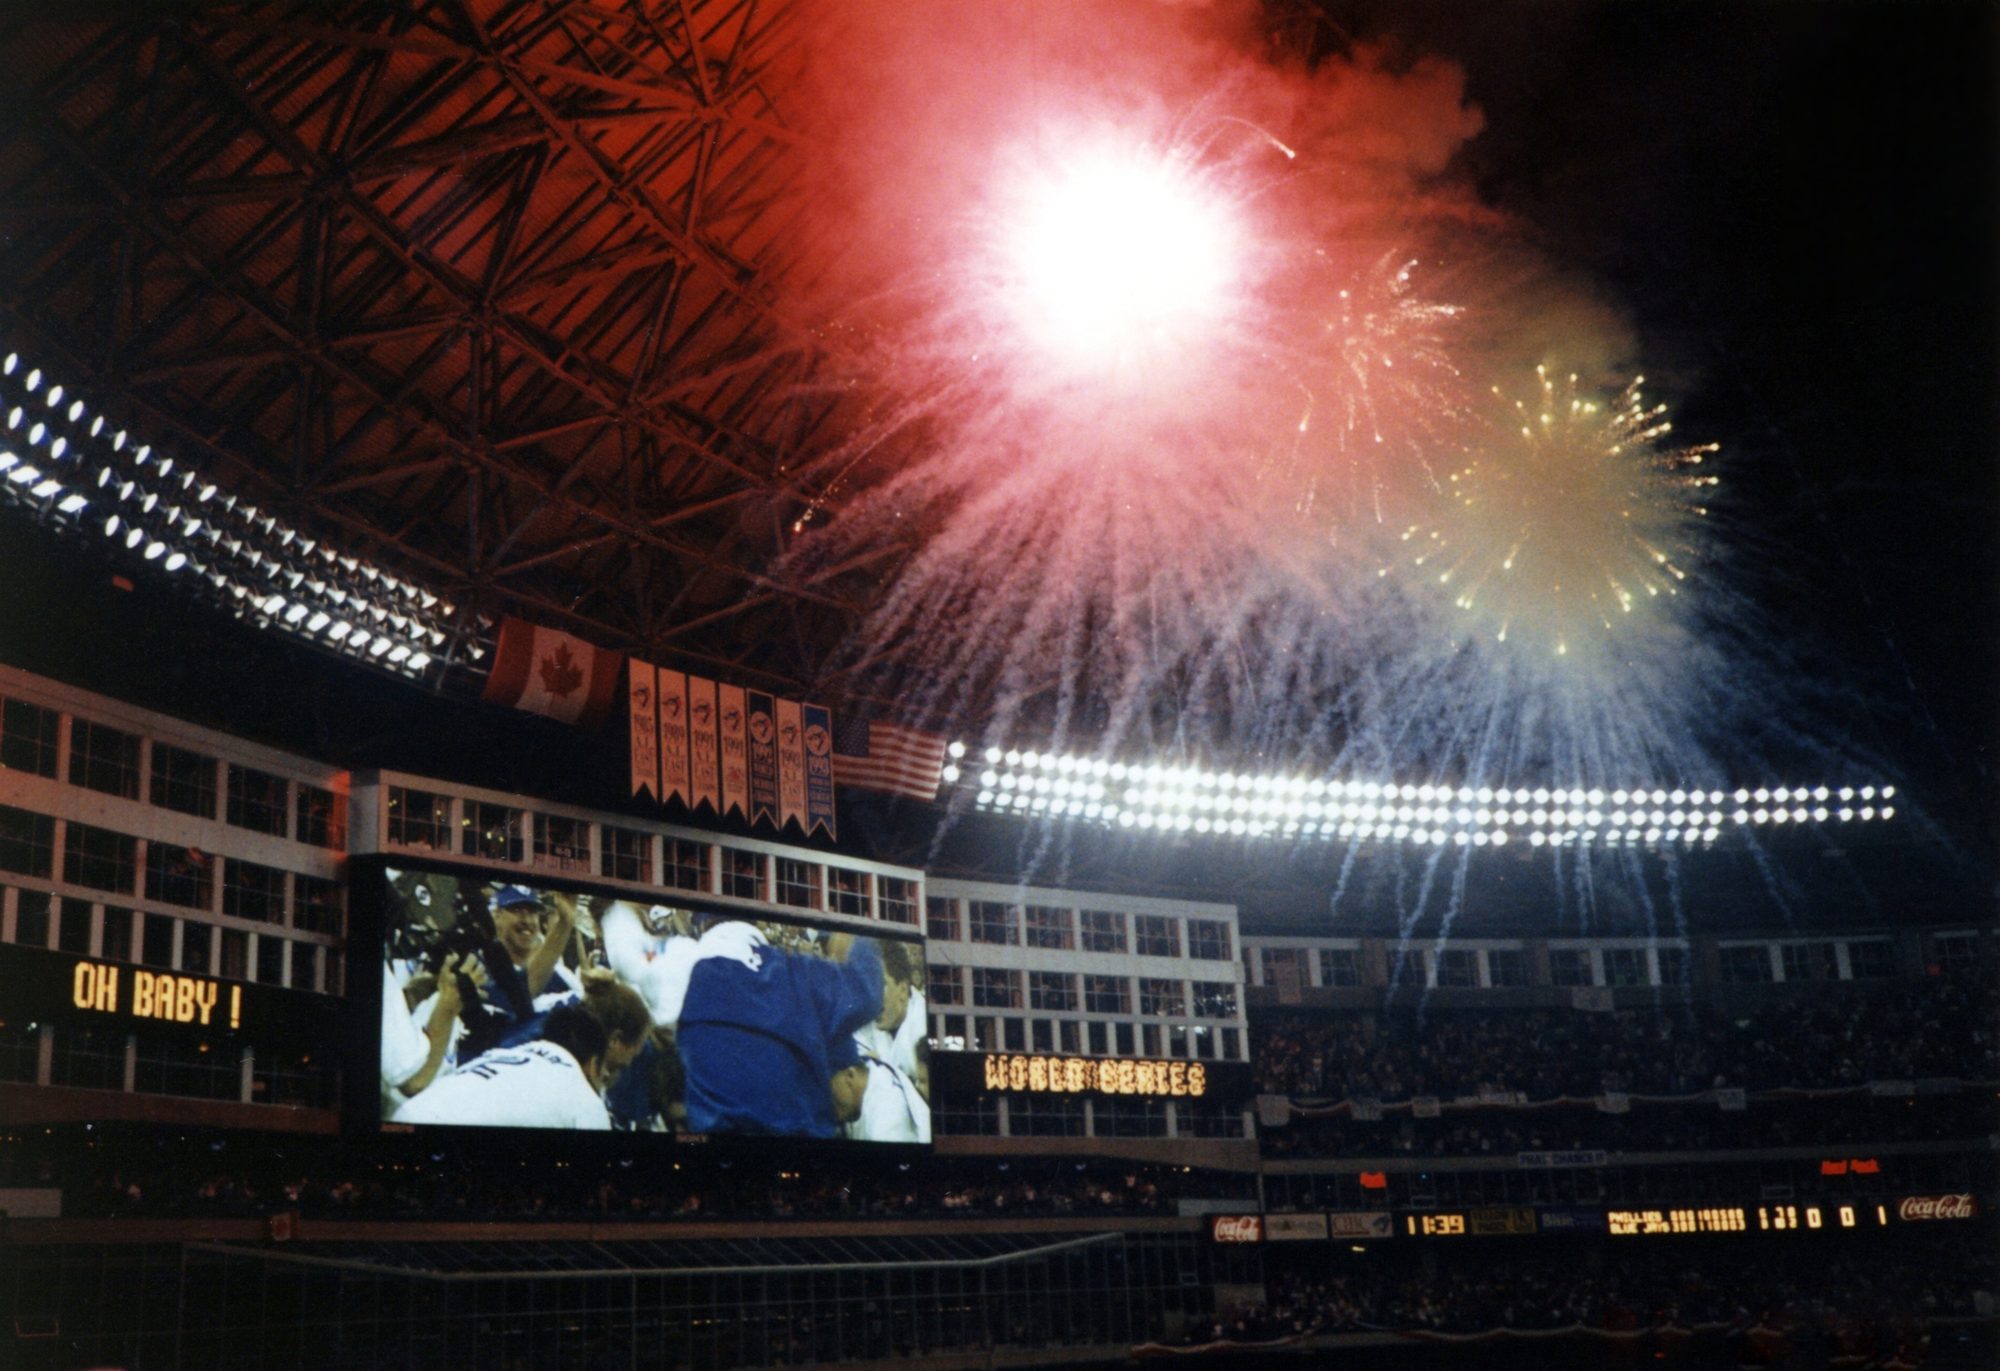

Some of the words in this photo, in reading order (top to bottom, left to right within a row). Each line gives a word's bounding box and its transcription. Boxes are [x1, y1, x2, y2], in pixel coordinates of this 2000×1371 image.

[74, 961, 118, 1012] OH
[133, 970, 217, 1025] BABY
[230, 985, 241, 1029] !
[1100, 1058, 1206, 1096] SERIES
[1407, 1214, 1465, 1236] 11:39
[1610, 1222, 1638, 1234] BLUE
[1643, 1221, 1670, 1233] JAYS
[1806, 1207, 1822, 1229] 0
[1840, 1206, 1856, 1227] 0
[1877, 1205, 1886, 1226] 1
